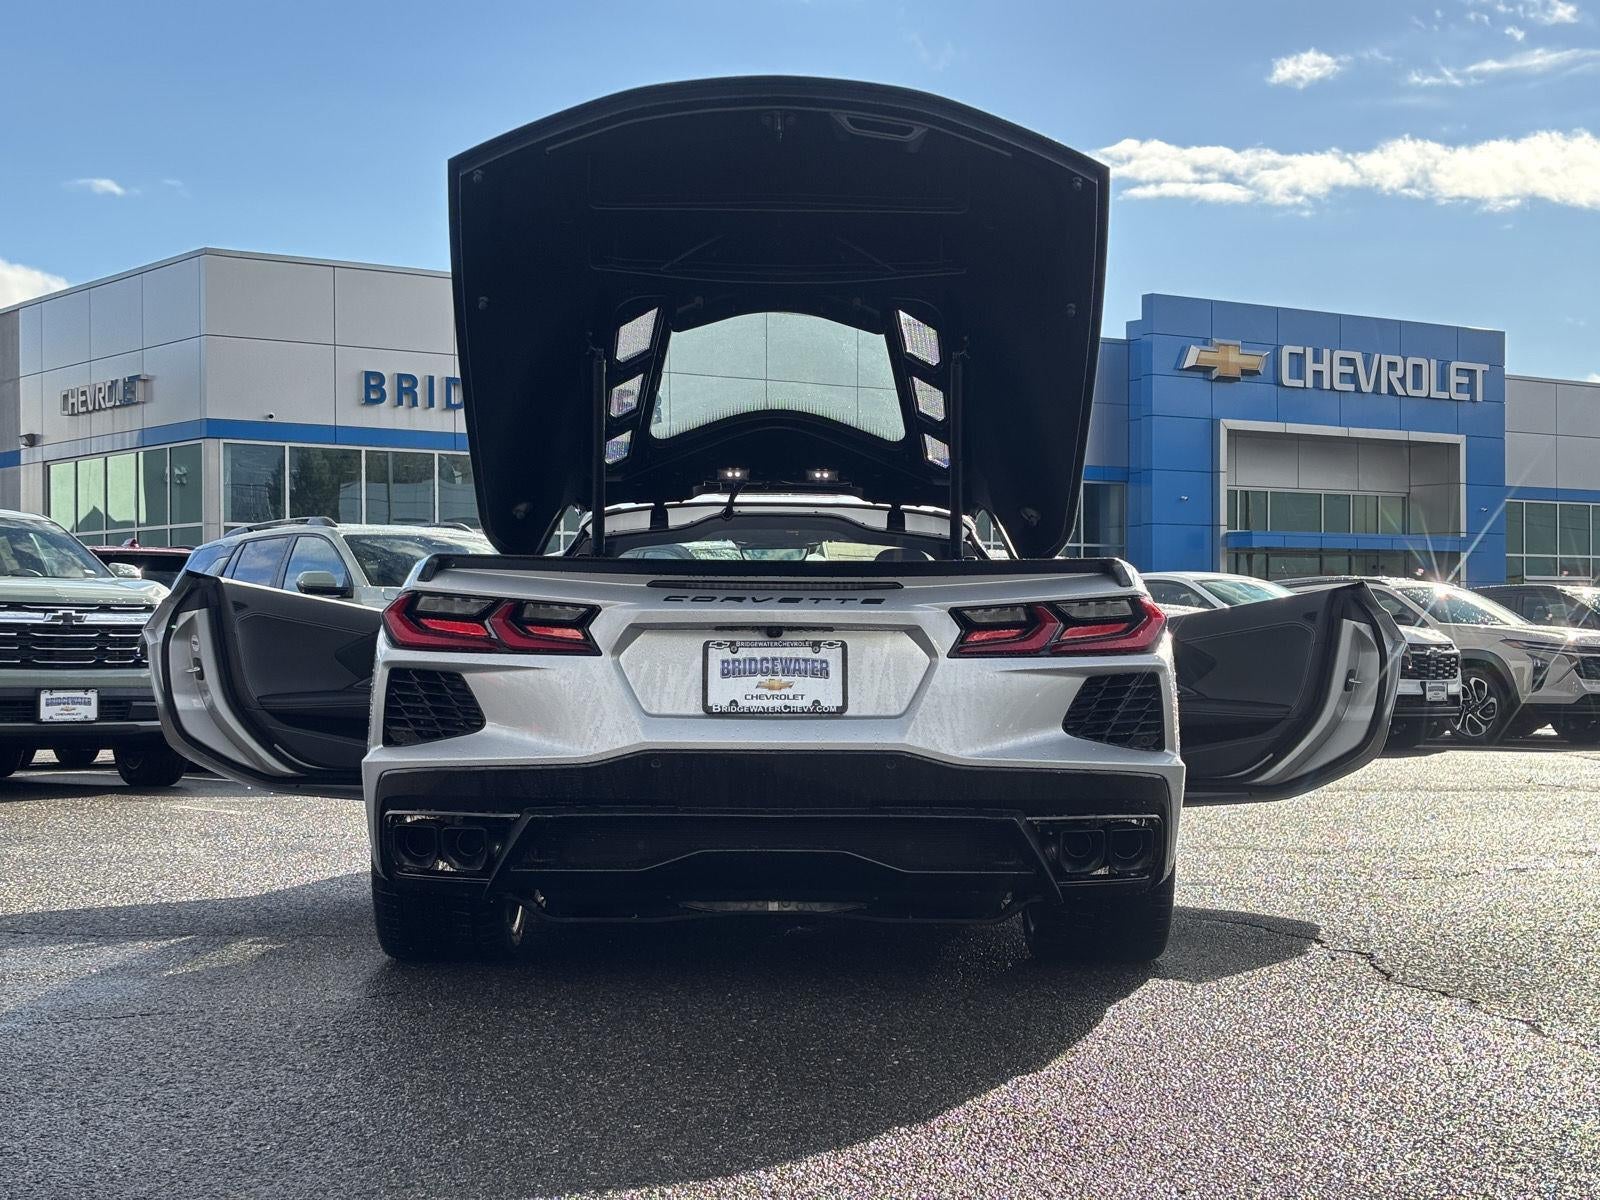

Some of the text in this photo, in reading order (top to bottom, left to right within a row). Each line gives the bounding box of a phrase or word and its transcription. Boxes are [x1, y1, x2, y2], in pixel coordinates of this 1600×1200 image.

[1281, 345, 1489, 402] CHEVROLET
[663, 595, 886, 605] CORVETTE
[720, 656, 830, 679] BRIDGEWATER
[744, 693, 806, 701] CHEVROLET
